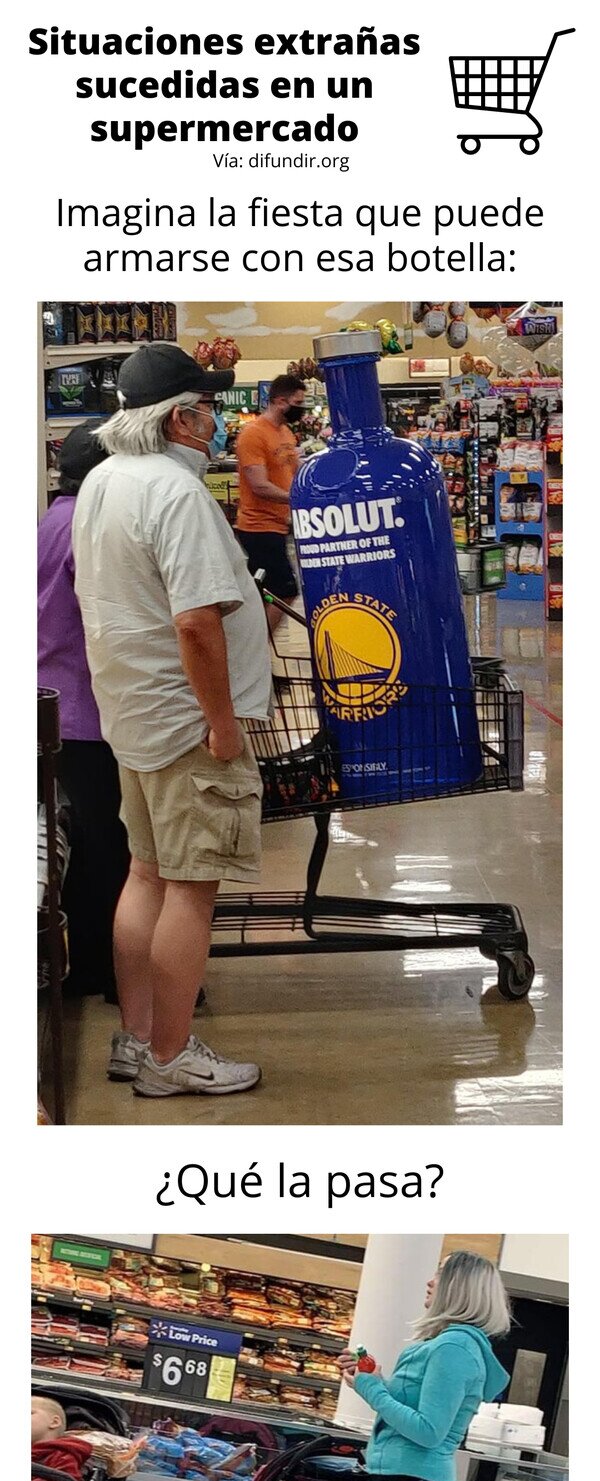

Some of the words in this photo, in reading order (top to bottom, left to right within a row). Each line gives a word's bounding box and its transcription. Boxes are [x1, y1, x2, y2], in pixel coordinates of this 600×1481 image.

[320, 540, 359, 554] PARTNER
[359, 538, 372, 549] OF
[372, 536, 390, 546] THE
[321, 555, 345, 567] STATE
[345, 549, 396, 564] WARRIORS
[354, 593, 397, 621] STATE
[168, 1330, 191, 1342] Low
[191, 1334, 218, 1347] Price
